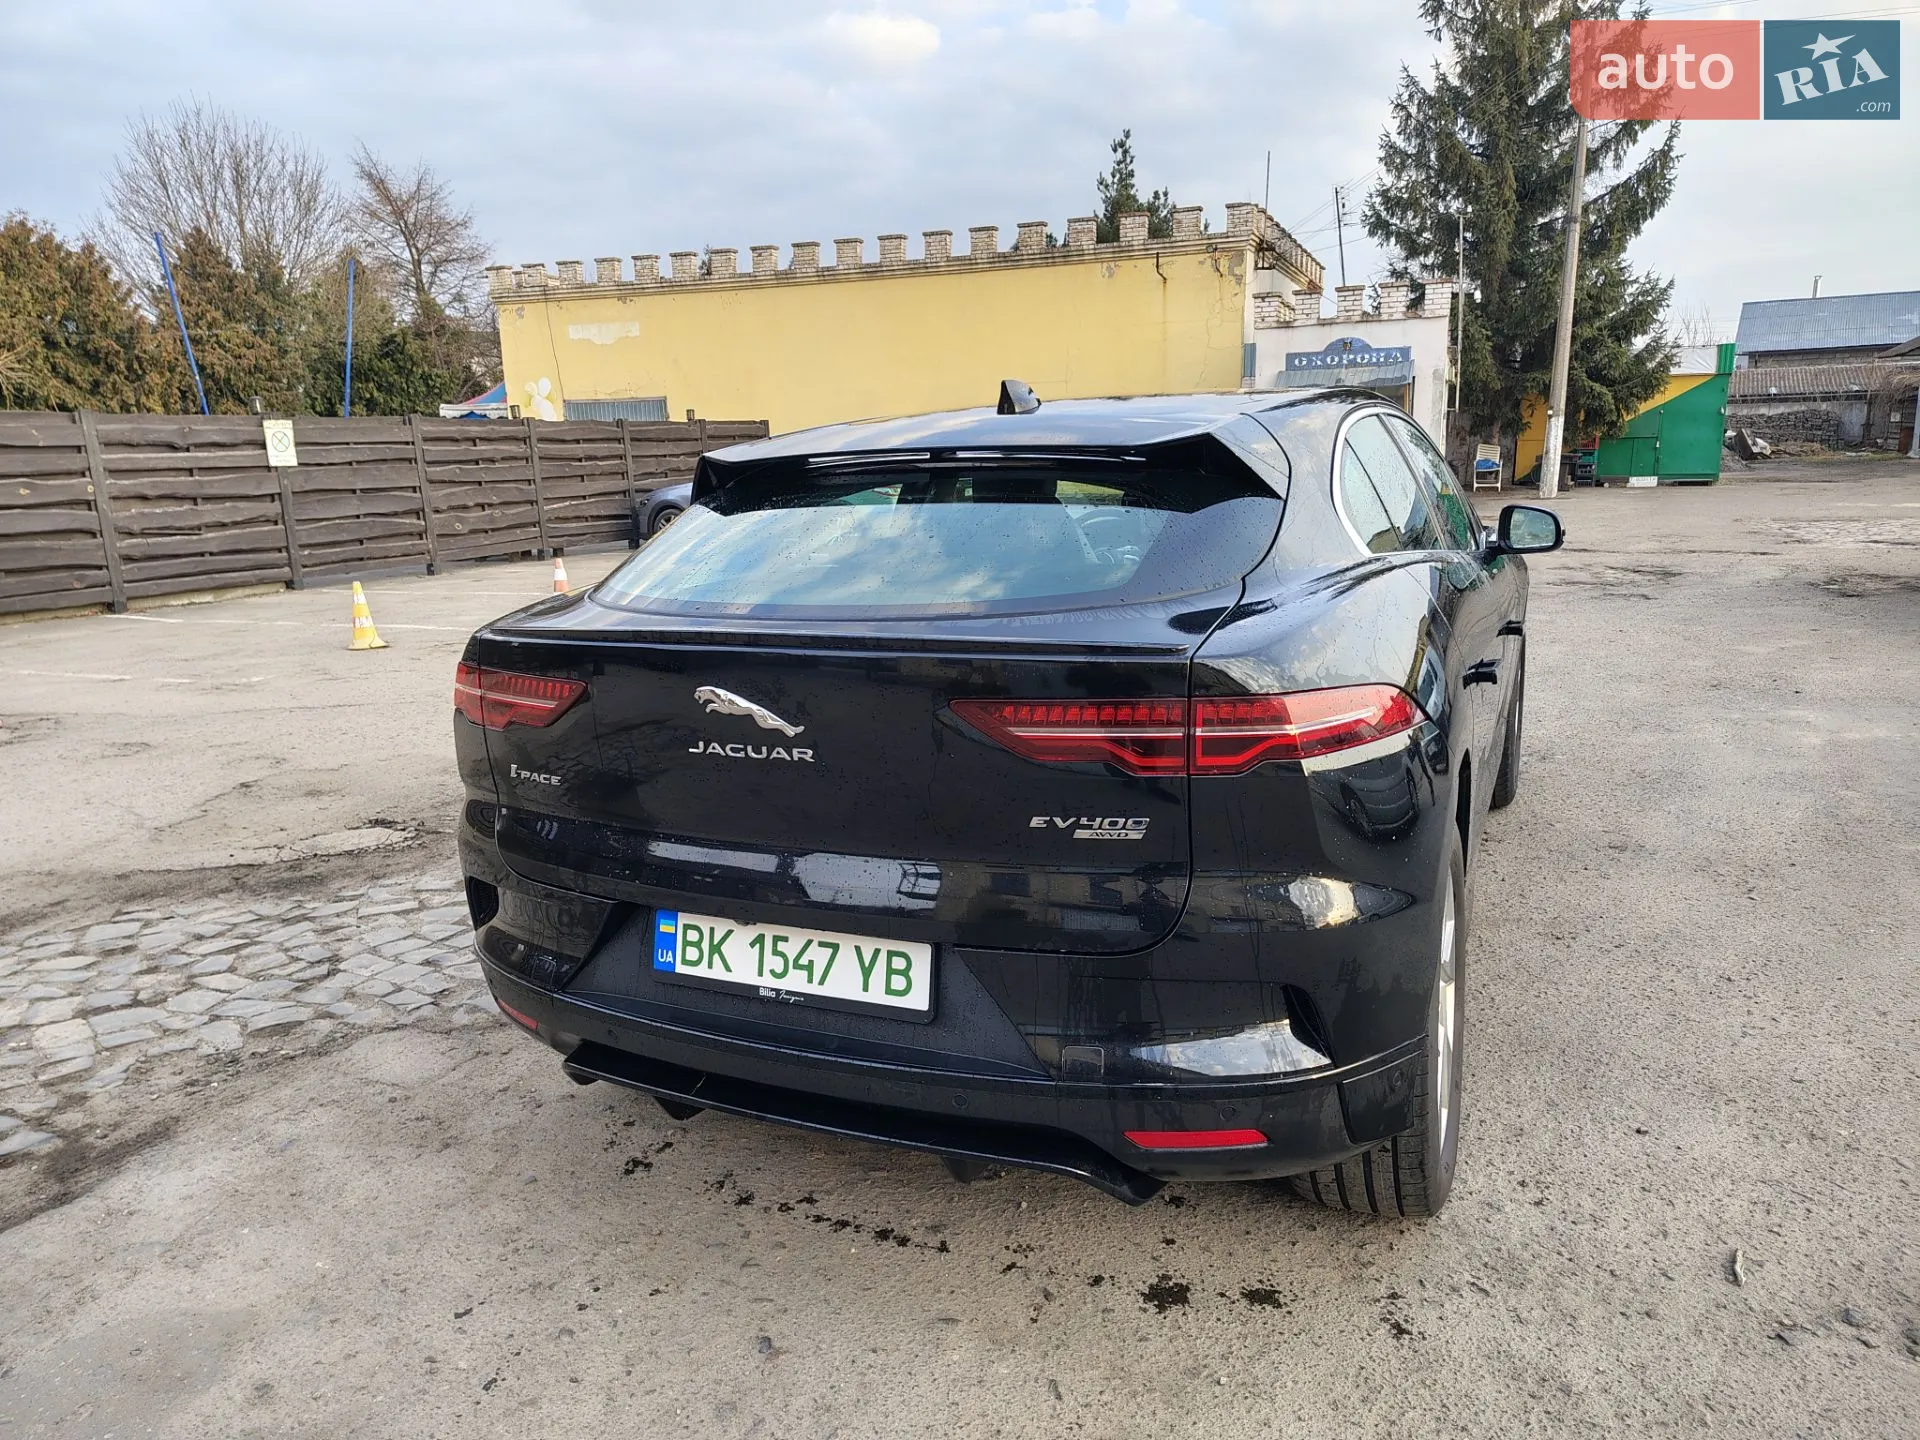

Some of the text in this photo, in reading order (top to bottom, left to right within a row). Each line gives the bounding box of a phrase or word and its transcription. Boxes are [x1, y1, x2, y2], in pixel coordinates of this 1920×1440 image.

[1294, 352, 1403, 367] ОХОРОНА
[688, 741, 815, 762] JAGUAR
[1029, 816, 1150, 830] EV400
[658, 949, 674, 964] UA
[680, 923, 913, 998] BK 1547 YB
[760, 987, 776, 998] Bilia
